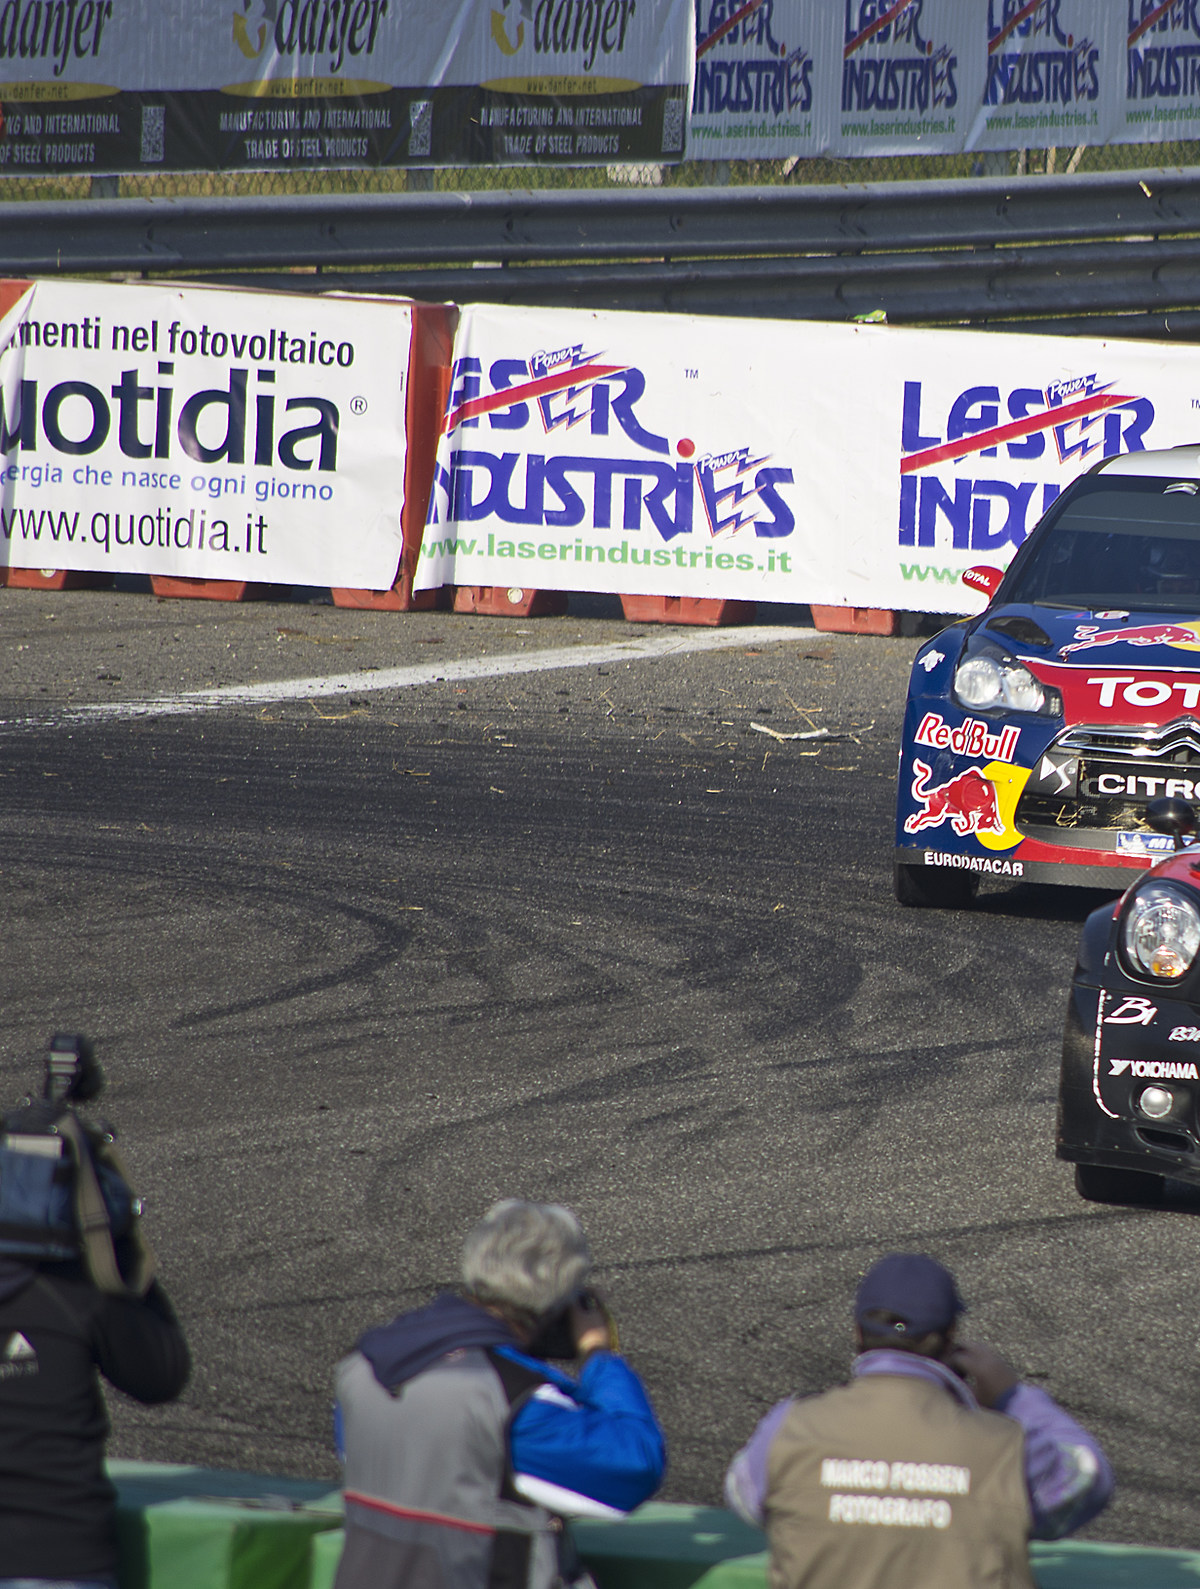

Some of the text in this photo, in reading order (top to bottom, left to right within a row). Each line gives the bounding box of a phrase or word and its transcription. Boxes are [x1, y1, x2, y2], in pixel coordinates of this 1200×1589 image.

[841, 116, 956, 137] www.laserindustries.it
[985, 108, 1099, 131] www.laserindustries.it
[45, 143, 96, 163] PRODUCTS
[575, 135, 620, 154] PRODUCTS
[10, 317, 355, 368] menti nel fotovoltaico
[446, 350, 671, 456] ASER
[0, 360, 340, 472] uotidia
[72, 465, 113, 486] che
[121, 471, 181, 489] nasce
[190, 475, 246, 499] ogni
[254, 477, 334, 502] giorno
[964, 569, 990, 587] TOTAL
[914, 712, 1022, 762] Red Bull
[924, 851, 1024, 877] EURODATACAR
[1130, 1060, 1200, 1080] YOKOHAMA
